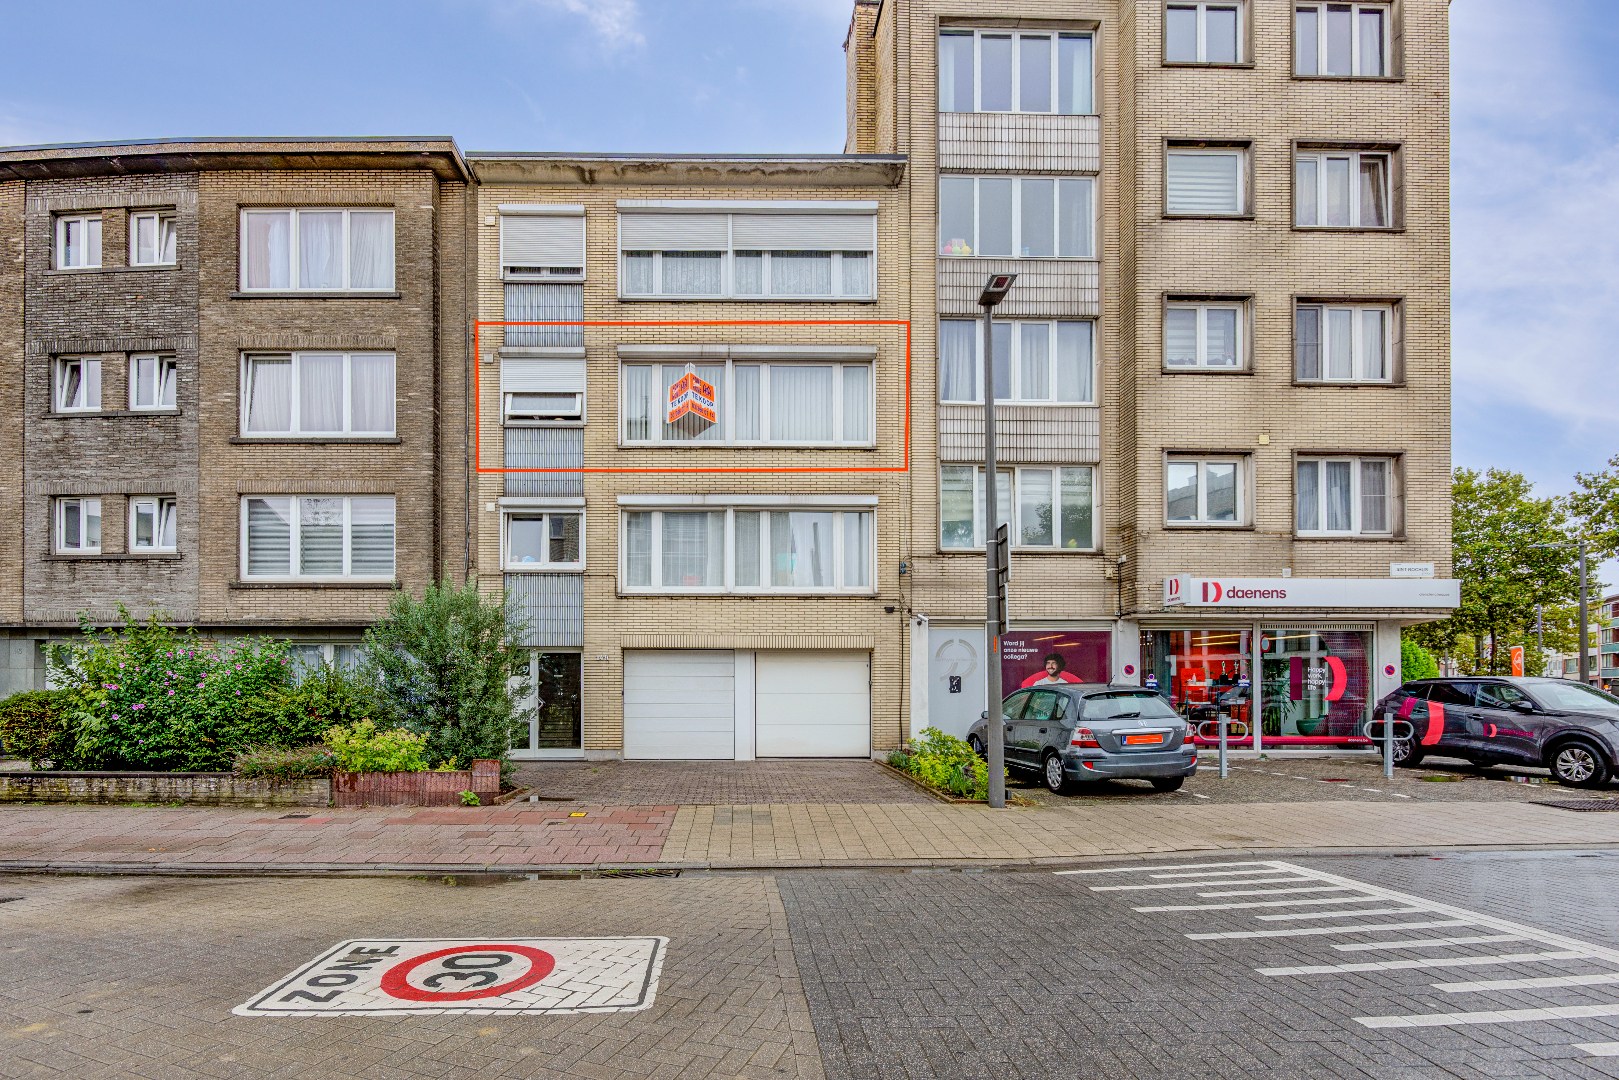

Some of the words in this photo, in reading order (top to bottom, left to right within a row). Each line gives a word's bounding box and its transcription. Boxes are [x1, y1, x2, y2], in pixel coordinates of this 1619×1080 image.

[1226, 586, 1287, 599] daenens
[277, 945, 401, 1002] ZONE
[422, 953, 513, 988] 30
